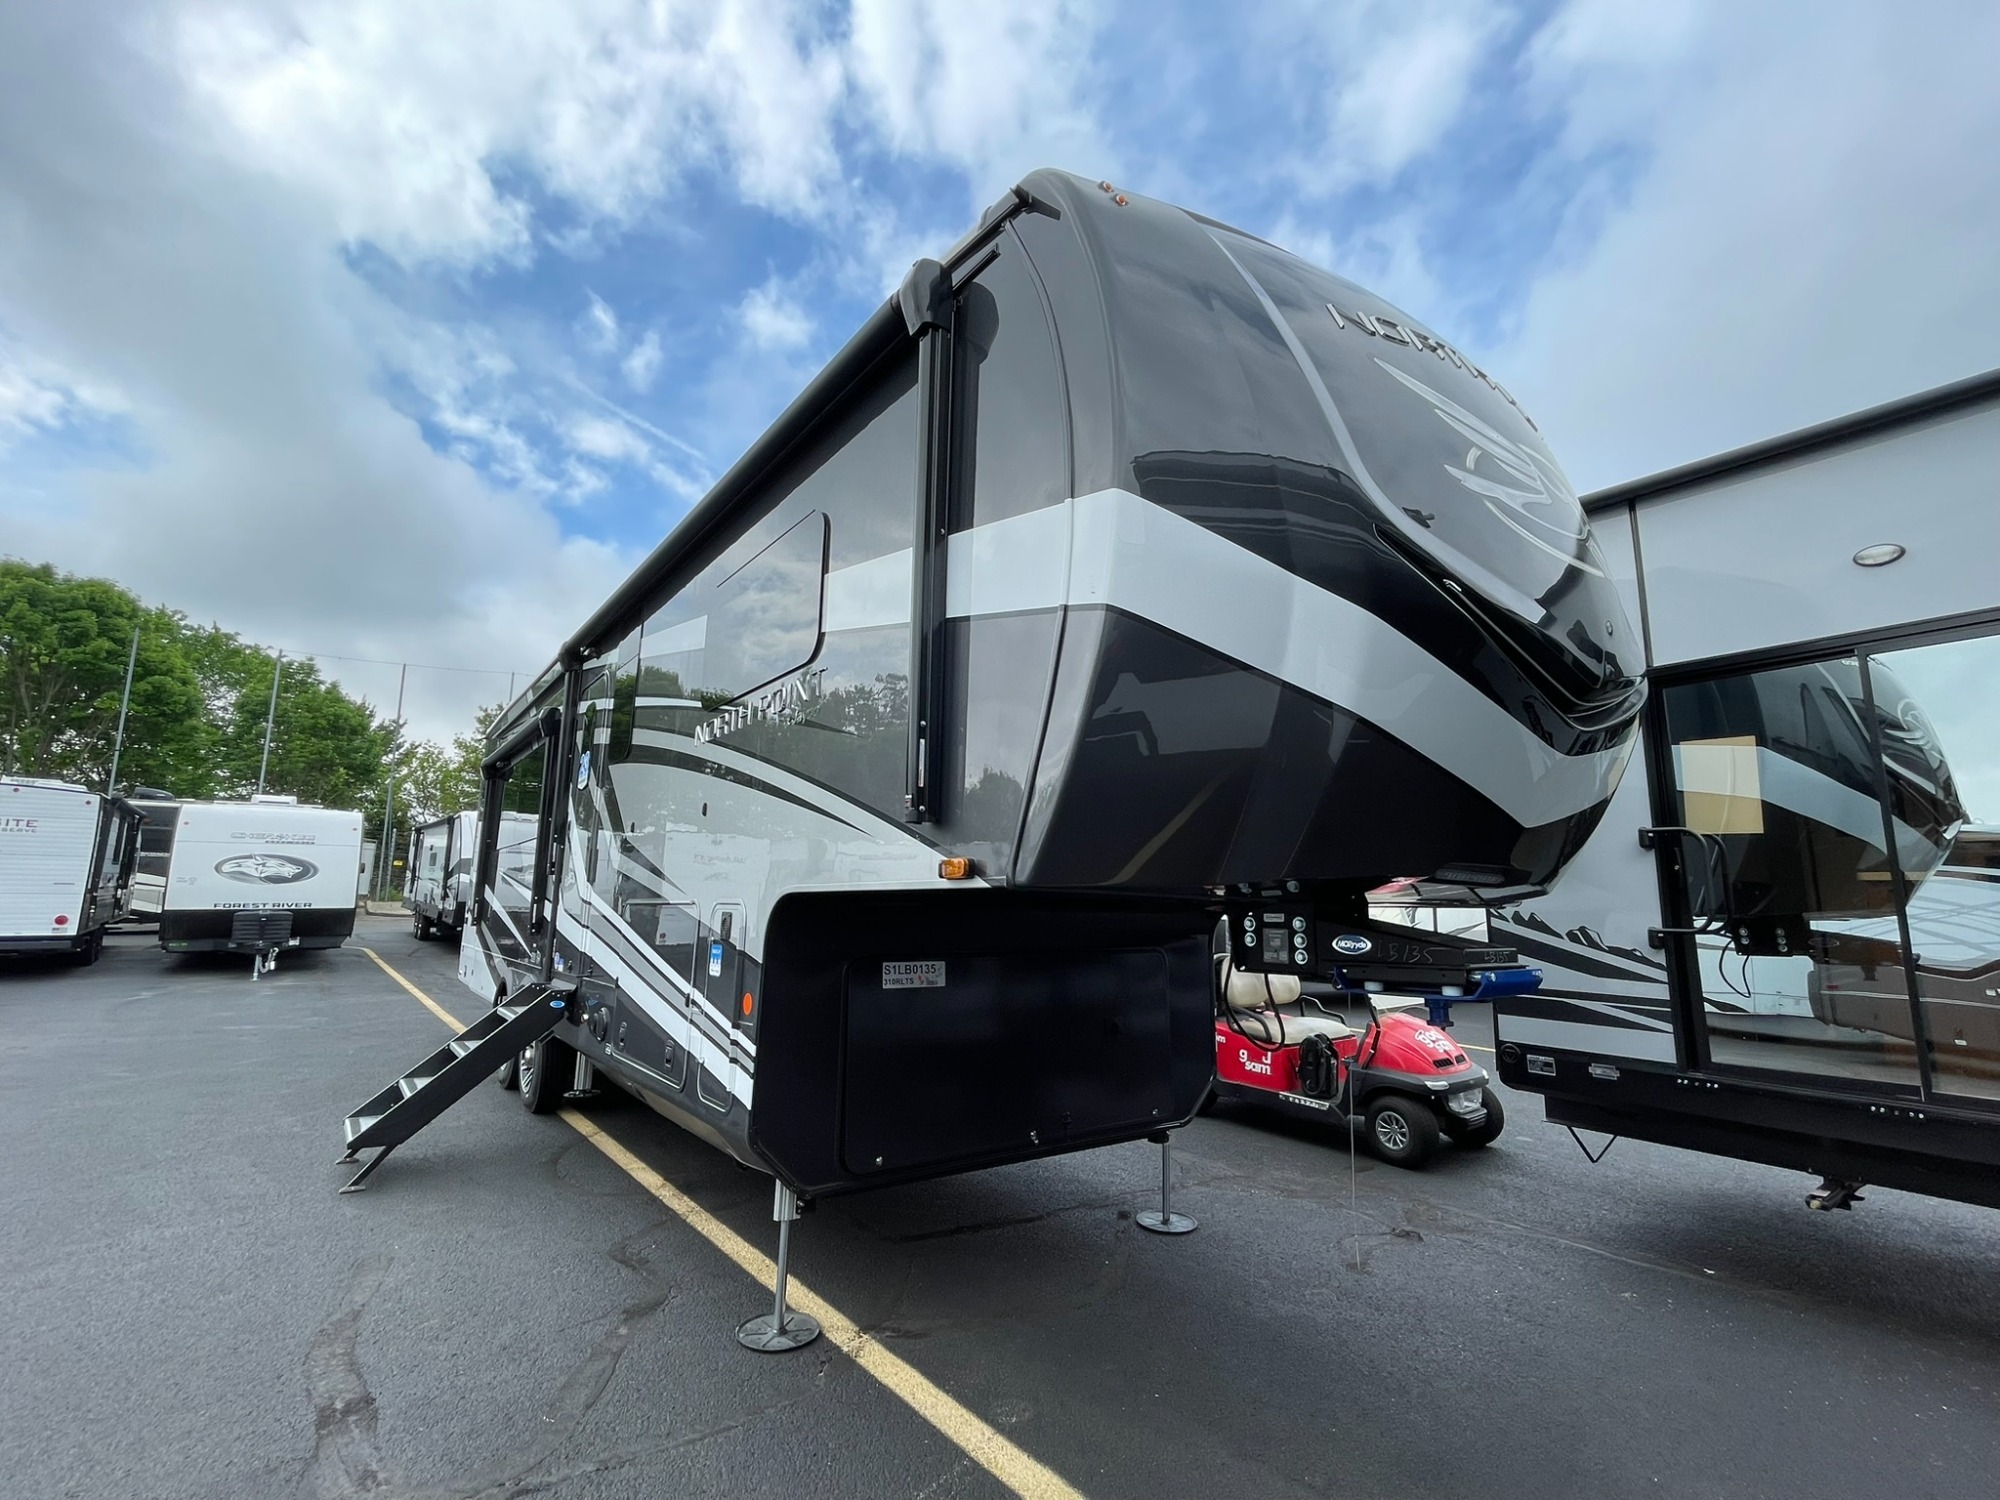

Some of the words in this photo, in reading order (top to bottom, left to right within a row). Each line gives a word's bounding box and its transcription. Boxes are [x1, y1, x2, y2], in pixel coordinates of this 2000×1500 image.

[694, 700, 754, 747] NORTH
[757, 667, 828, 721] POINT
[0, 818, 38, 828] ITE
[884, 963, 936, 976] S1LB0135
[1244, 1060, 1272, 1075] sam
